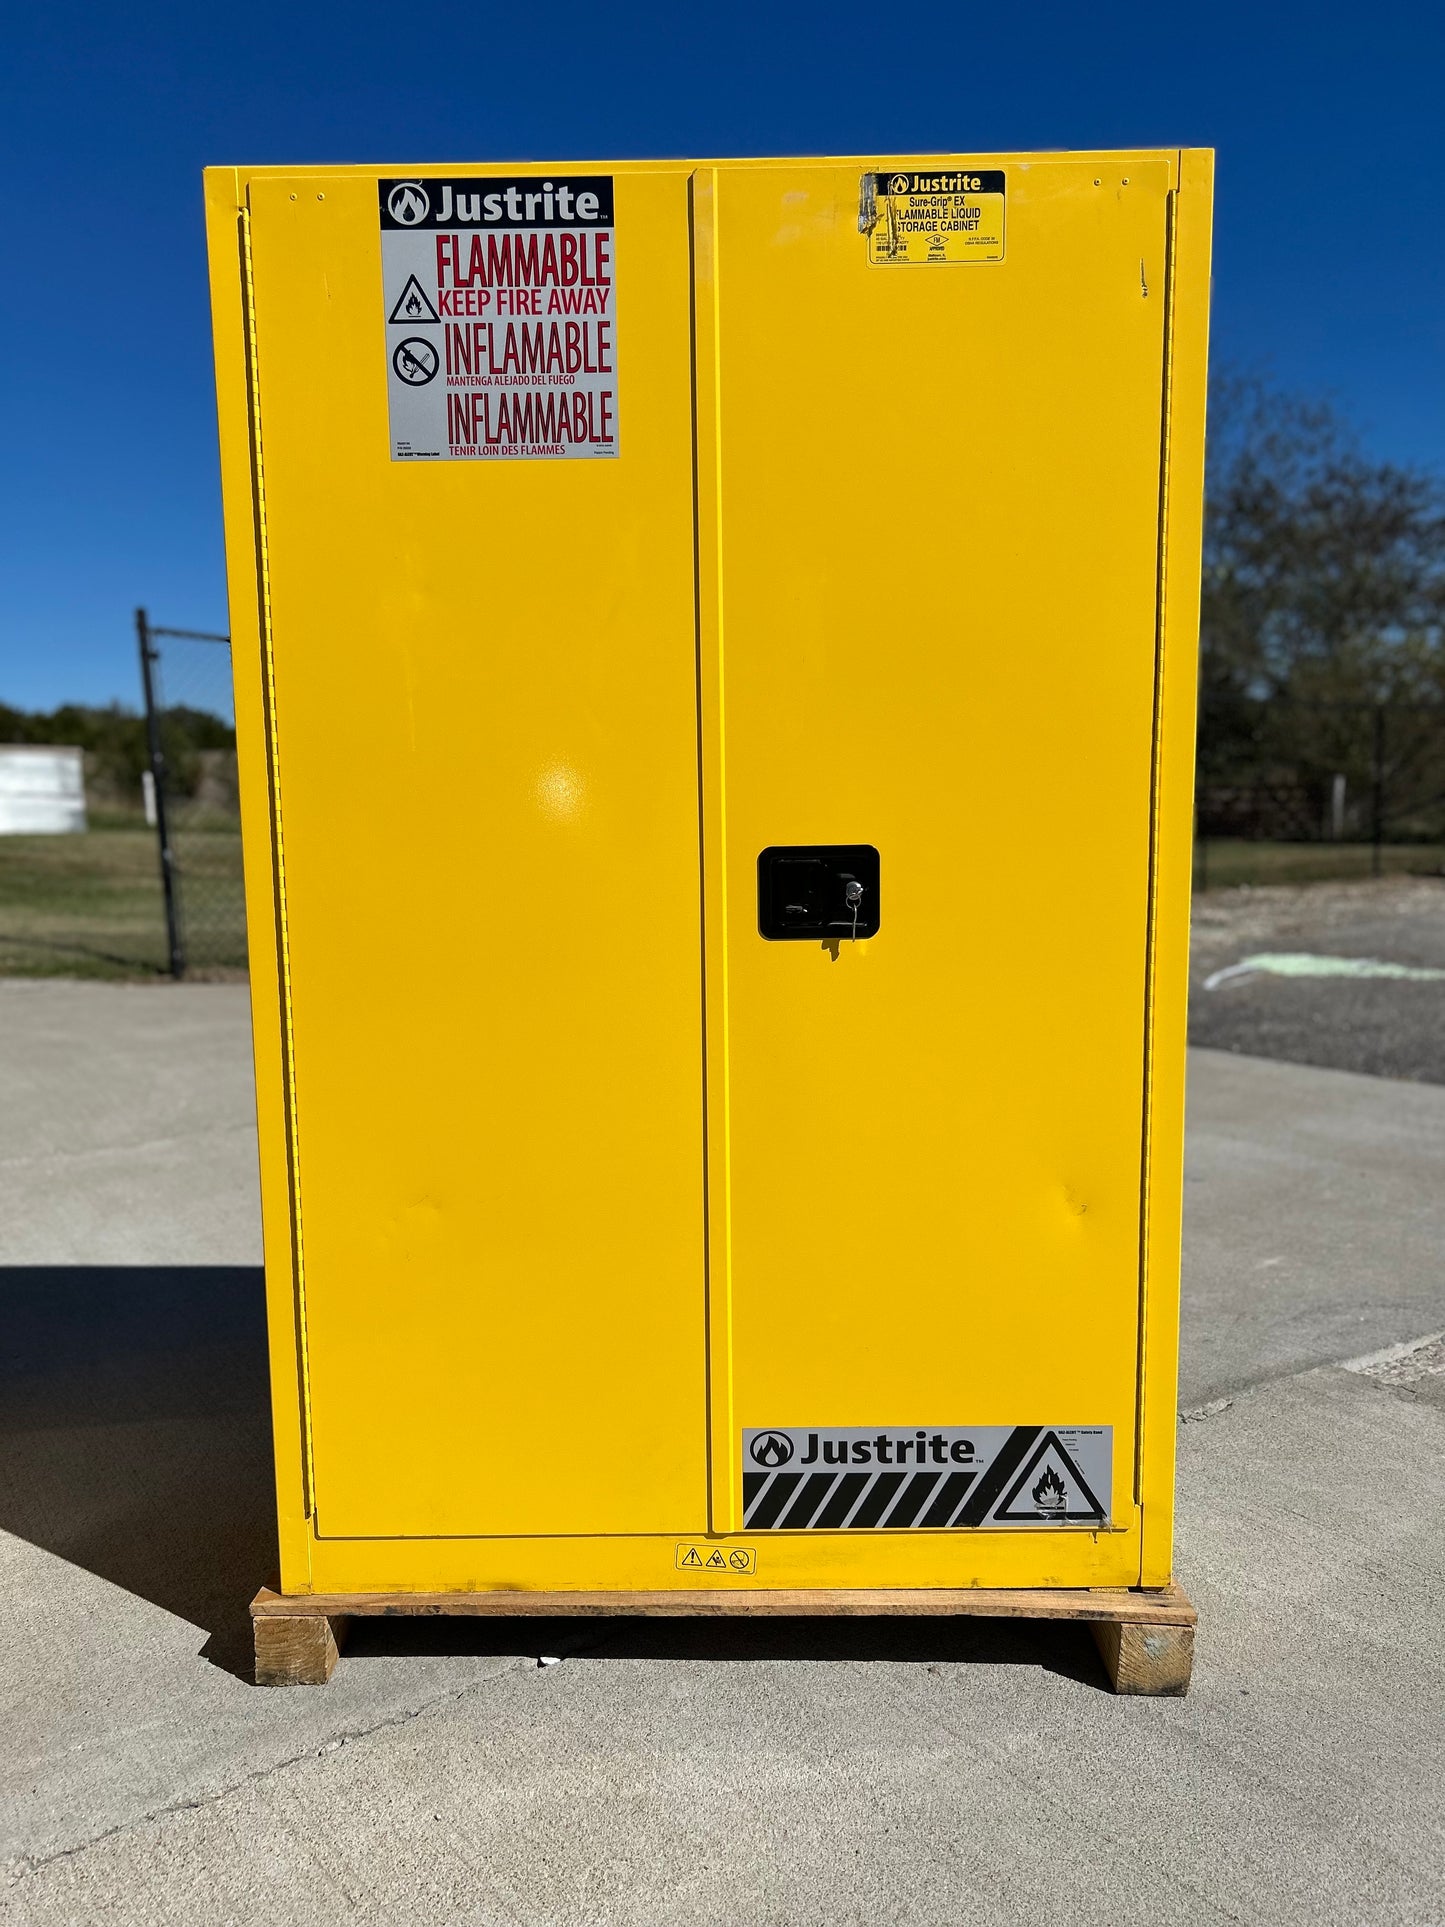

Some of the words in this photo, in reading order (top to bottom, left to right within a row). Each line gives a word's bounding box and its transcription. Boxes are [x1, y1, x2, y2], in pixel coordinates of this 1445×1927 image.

[911, 173, 982, 192] Justrite
[954, 196, 965, 206] EX
[896, 208, 948, 220] LAMMABLE
[951, 207, 981, 219] LIQUID
[940, 220, 979, 232] CABINET
[436, 233, 611, 289] FLAMMABLE
[437, 289, 491, 317] KEEP
[497, 288, 543, 316] FIRE
[547, 288, 610, 316] AWAY
[444, 321, 612, 375] INFLAMABLE
[446, 376, 493, 387] MANTENGA
[494, 375, 530, 386] ALEJADO
[532, 375, 548, 386] DEL
[548, 375, 575, 385] FUEGO
[447, 391, 614, 445] INFLAMMABLE
[448, 446, 476, 456] TENIR
[477, 446, 500, 456] LOIN
[501, 445, 518, 455] DES
[518, 445, 565, 455] FLAMMES
